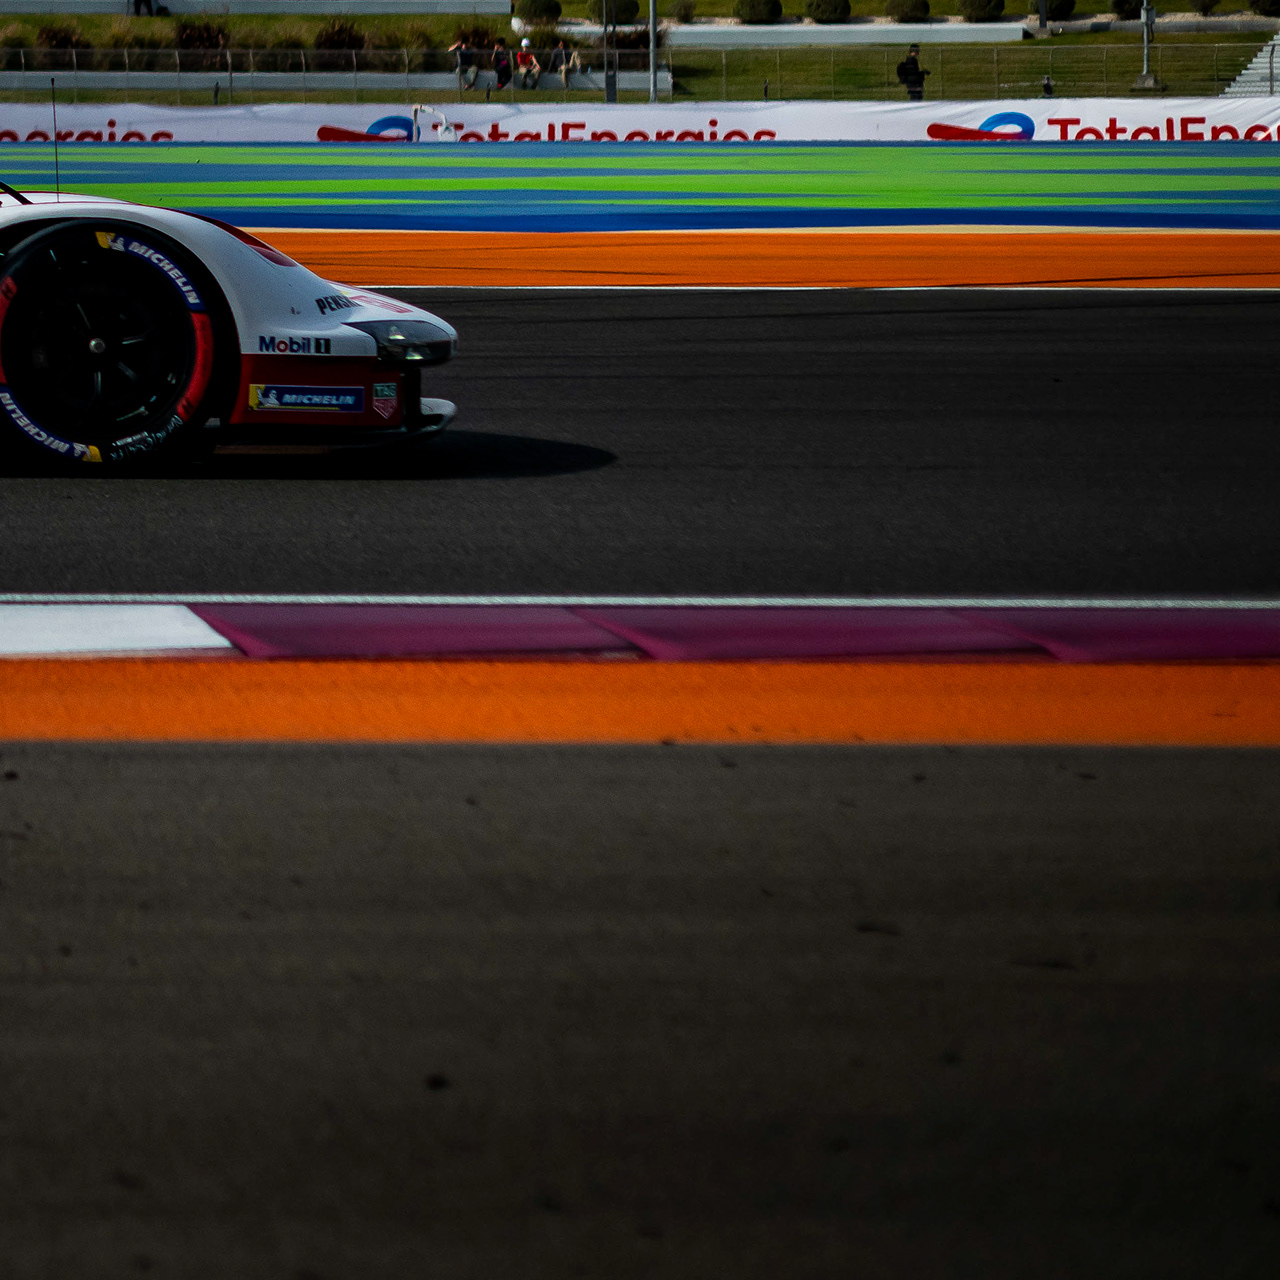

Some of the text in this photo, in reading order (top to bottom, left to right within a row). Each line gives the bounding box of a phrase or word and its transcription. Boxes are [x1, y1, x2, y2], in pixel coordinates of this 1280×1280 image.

[1048, 117, 1280, 141] TotalEne
[127, 241, 199, 304] MICHELIN
[315, 295, 362, 315] PENSK
[259, 335, 310, 354] Mobil
[283, 393, 356, 405] MICHELIN
